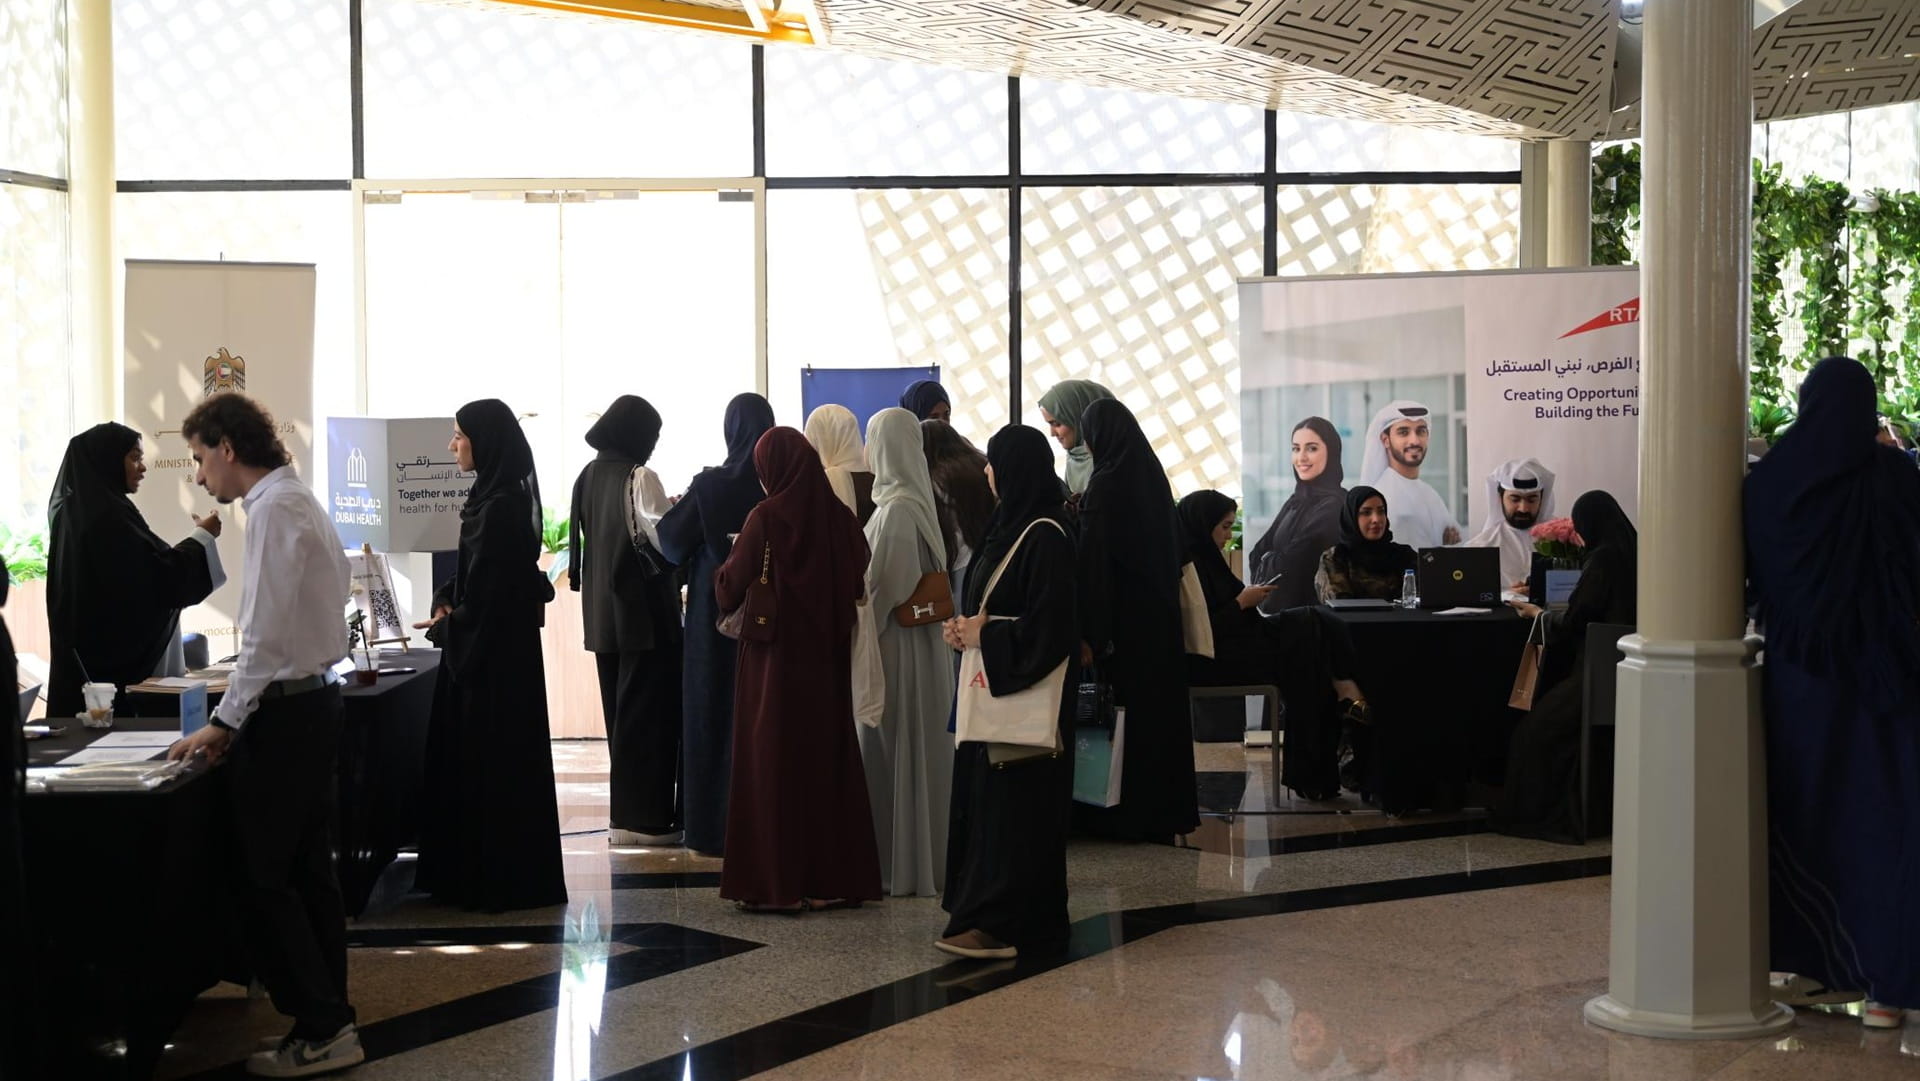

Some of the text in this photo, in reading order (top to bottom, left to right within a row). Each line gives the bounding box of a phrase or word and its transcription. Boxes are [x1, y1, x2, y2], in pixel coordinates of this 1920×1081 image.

[1486, 358, 1551, 377] المستقبل
[1555, 357, 1582, 378] نبني
[1503, 385, 1639, 403] Creating Opportuni
[1535, 404, 1639, 421] Building the Fu
[154, 458, 194, 469] MINISTR
[398, 487, 470, 502] Together we ad
[400, 502, 464, 514] health for hu
[335, 511, 382, 526] DUBAI HEALTH
[969, 671, 988, 689] A
